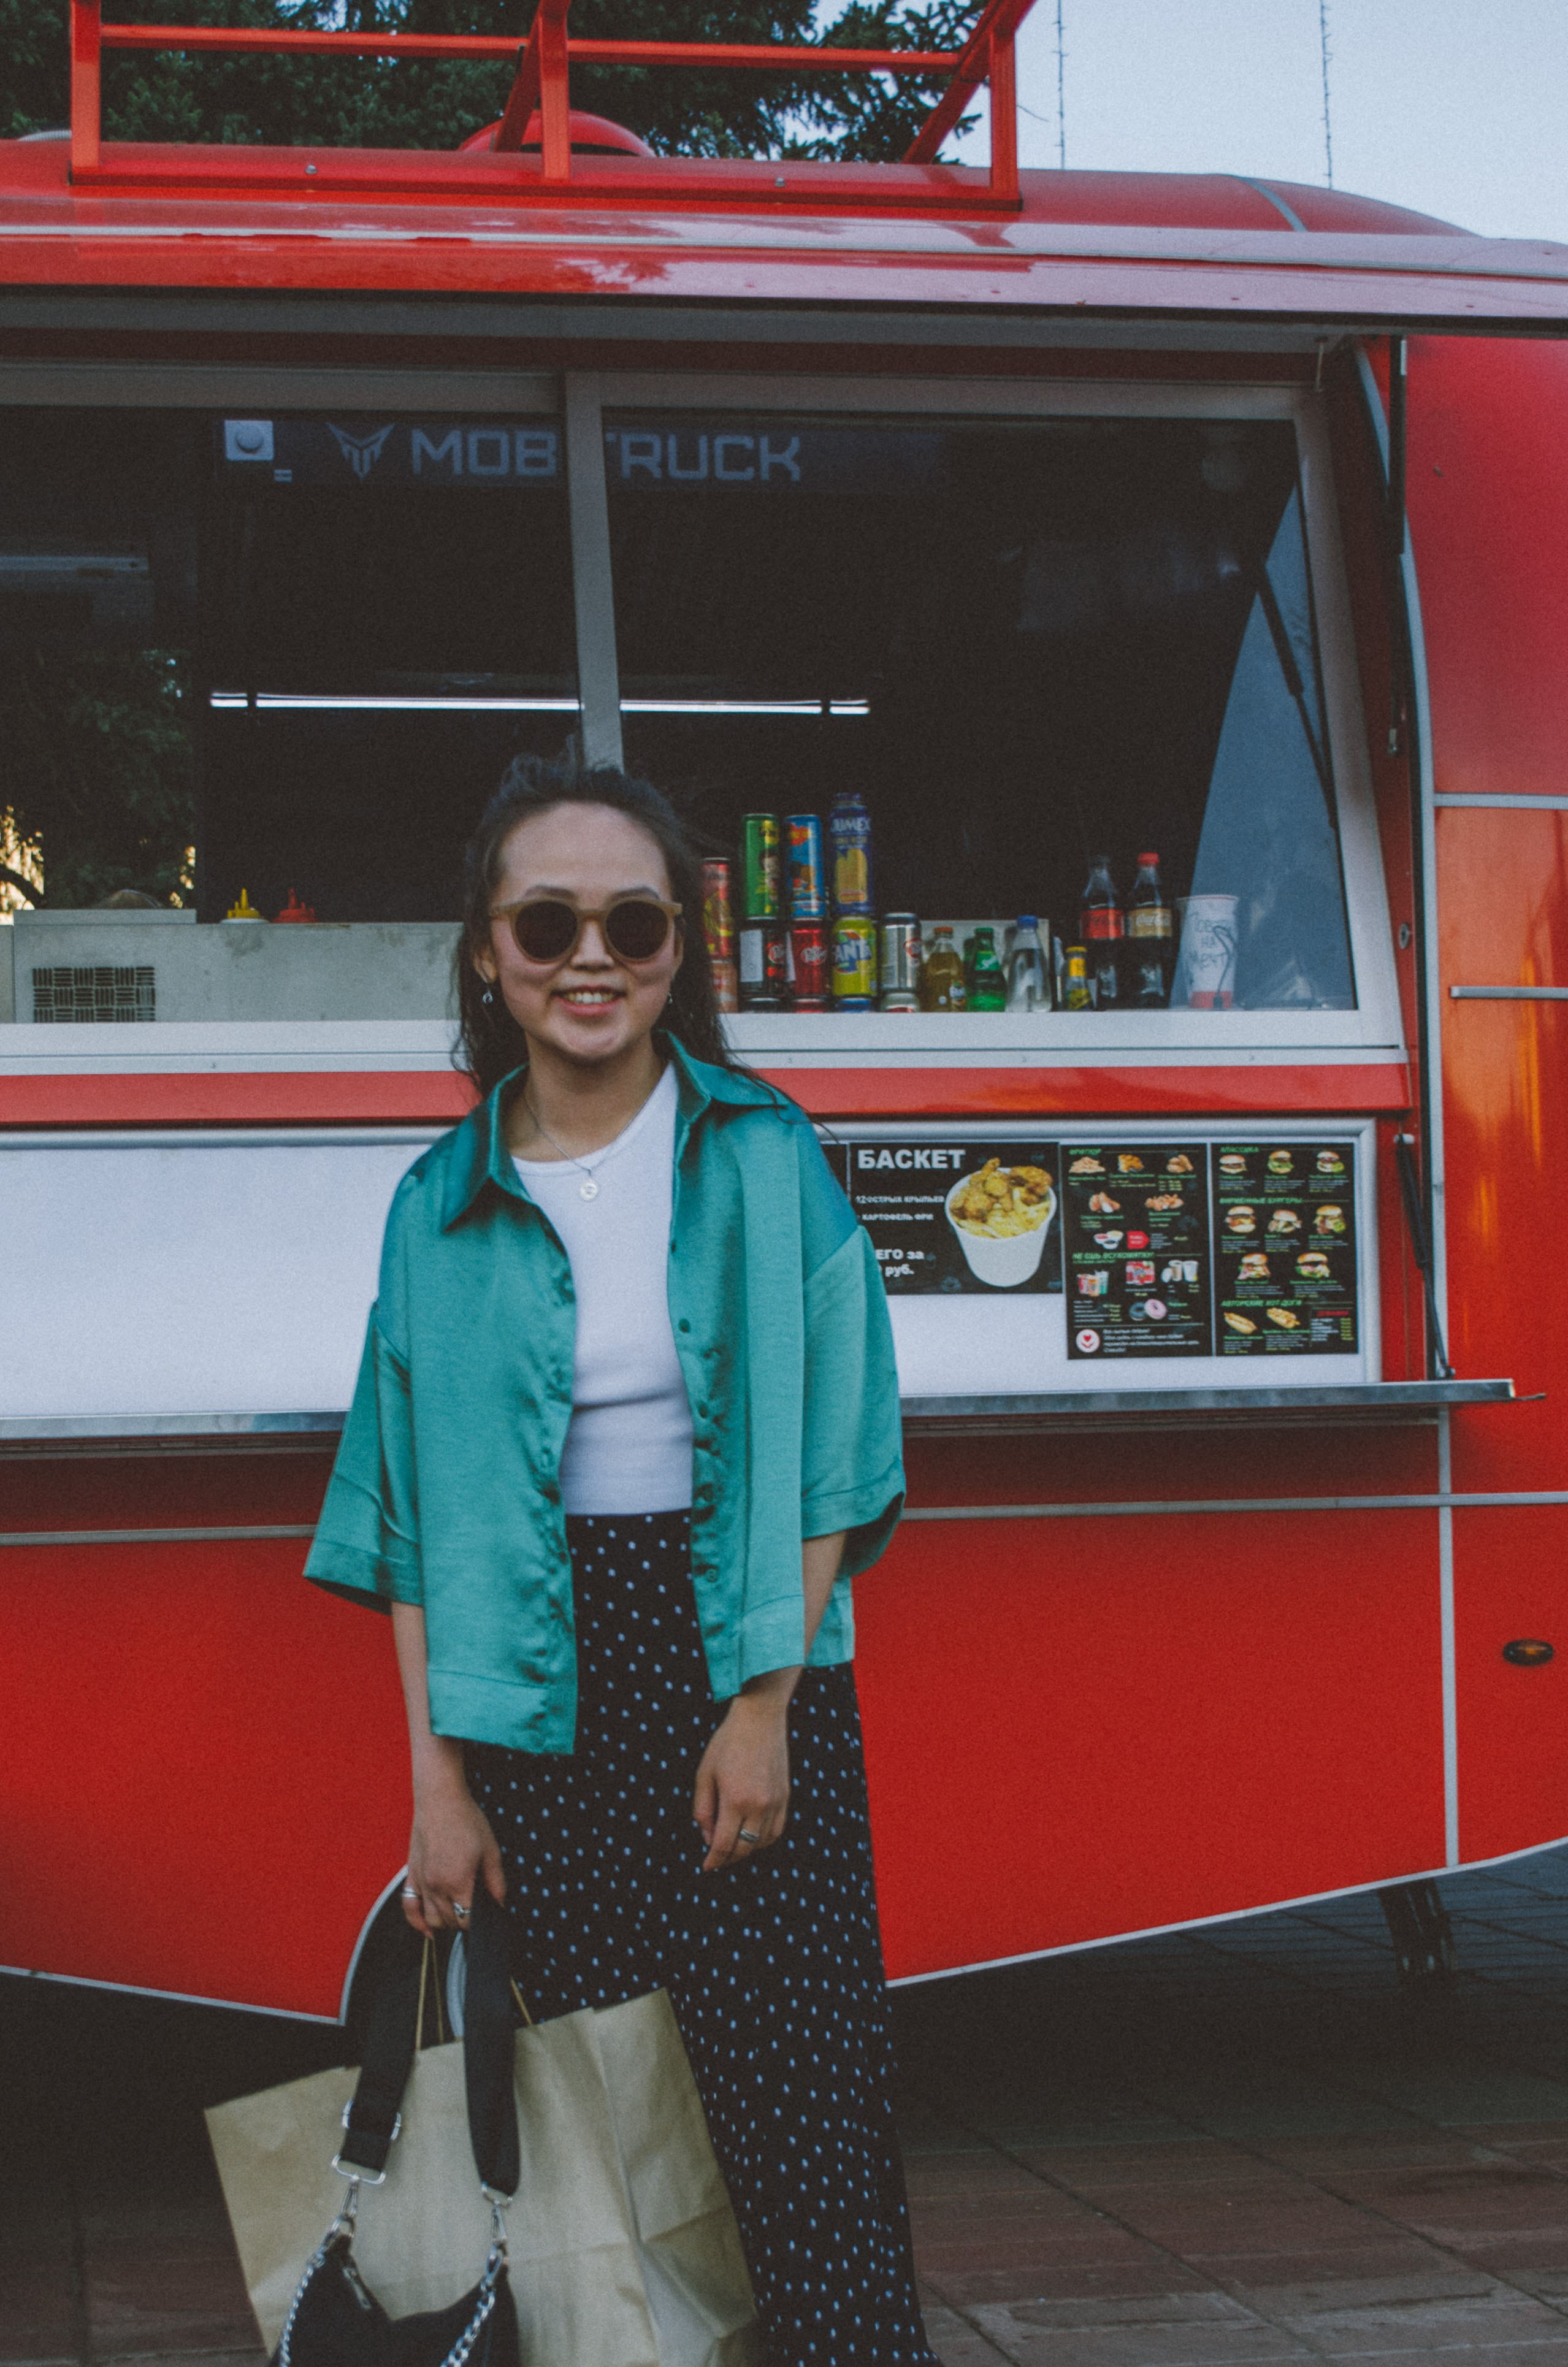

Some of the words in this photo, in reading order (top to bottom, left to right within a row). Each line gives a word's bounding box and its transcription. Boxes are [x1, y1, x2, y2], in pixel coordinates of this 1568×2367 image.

[605, 432, 801, 481] RUCK
[858, 1149, 966, 1169] БАСКЕТ
[875, 1249, 904, 1260] ЕГО
[906, 1251, 924, 1260] за
[885, 1263, 914, 1277] руб.
